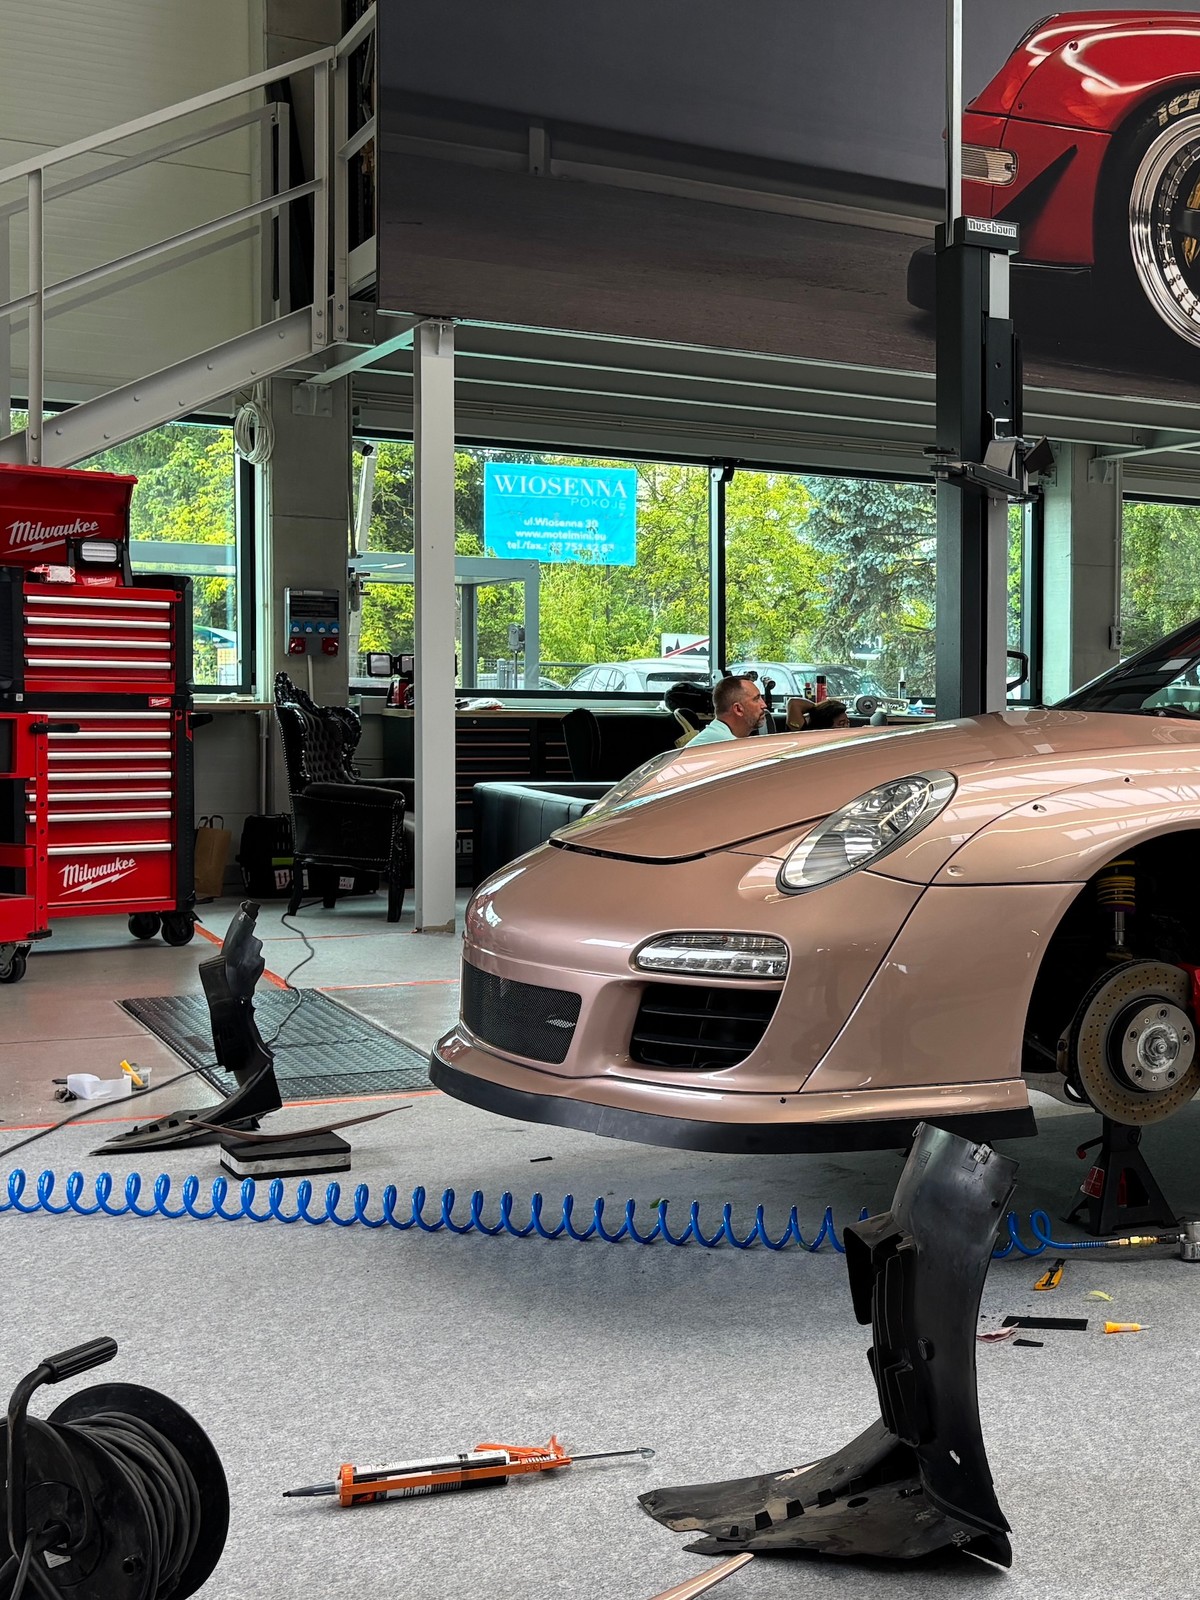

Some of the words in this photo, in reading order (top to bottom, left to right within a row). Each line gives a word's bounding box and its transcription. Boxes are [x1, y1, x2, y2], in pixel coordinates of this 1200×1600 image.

[493, 474, 628, 499] WIOSENNA
[5, 518, 100, 546] Milwaukee
[58, 857, 137, 888] Milwaukee
